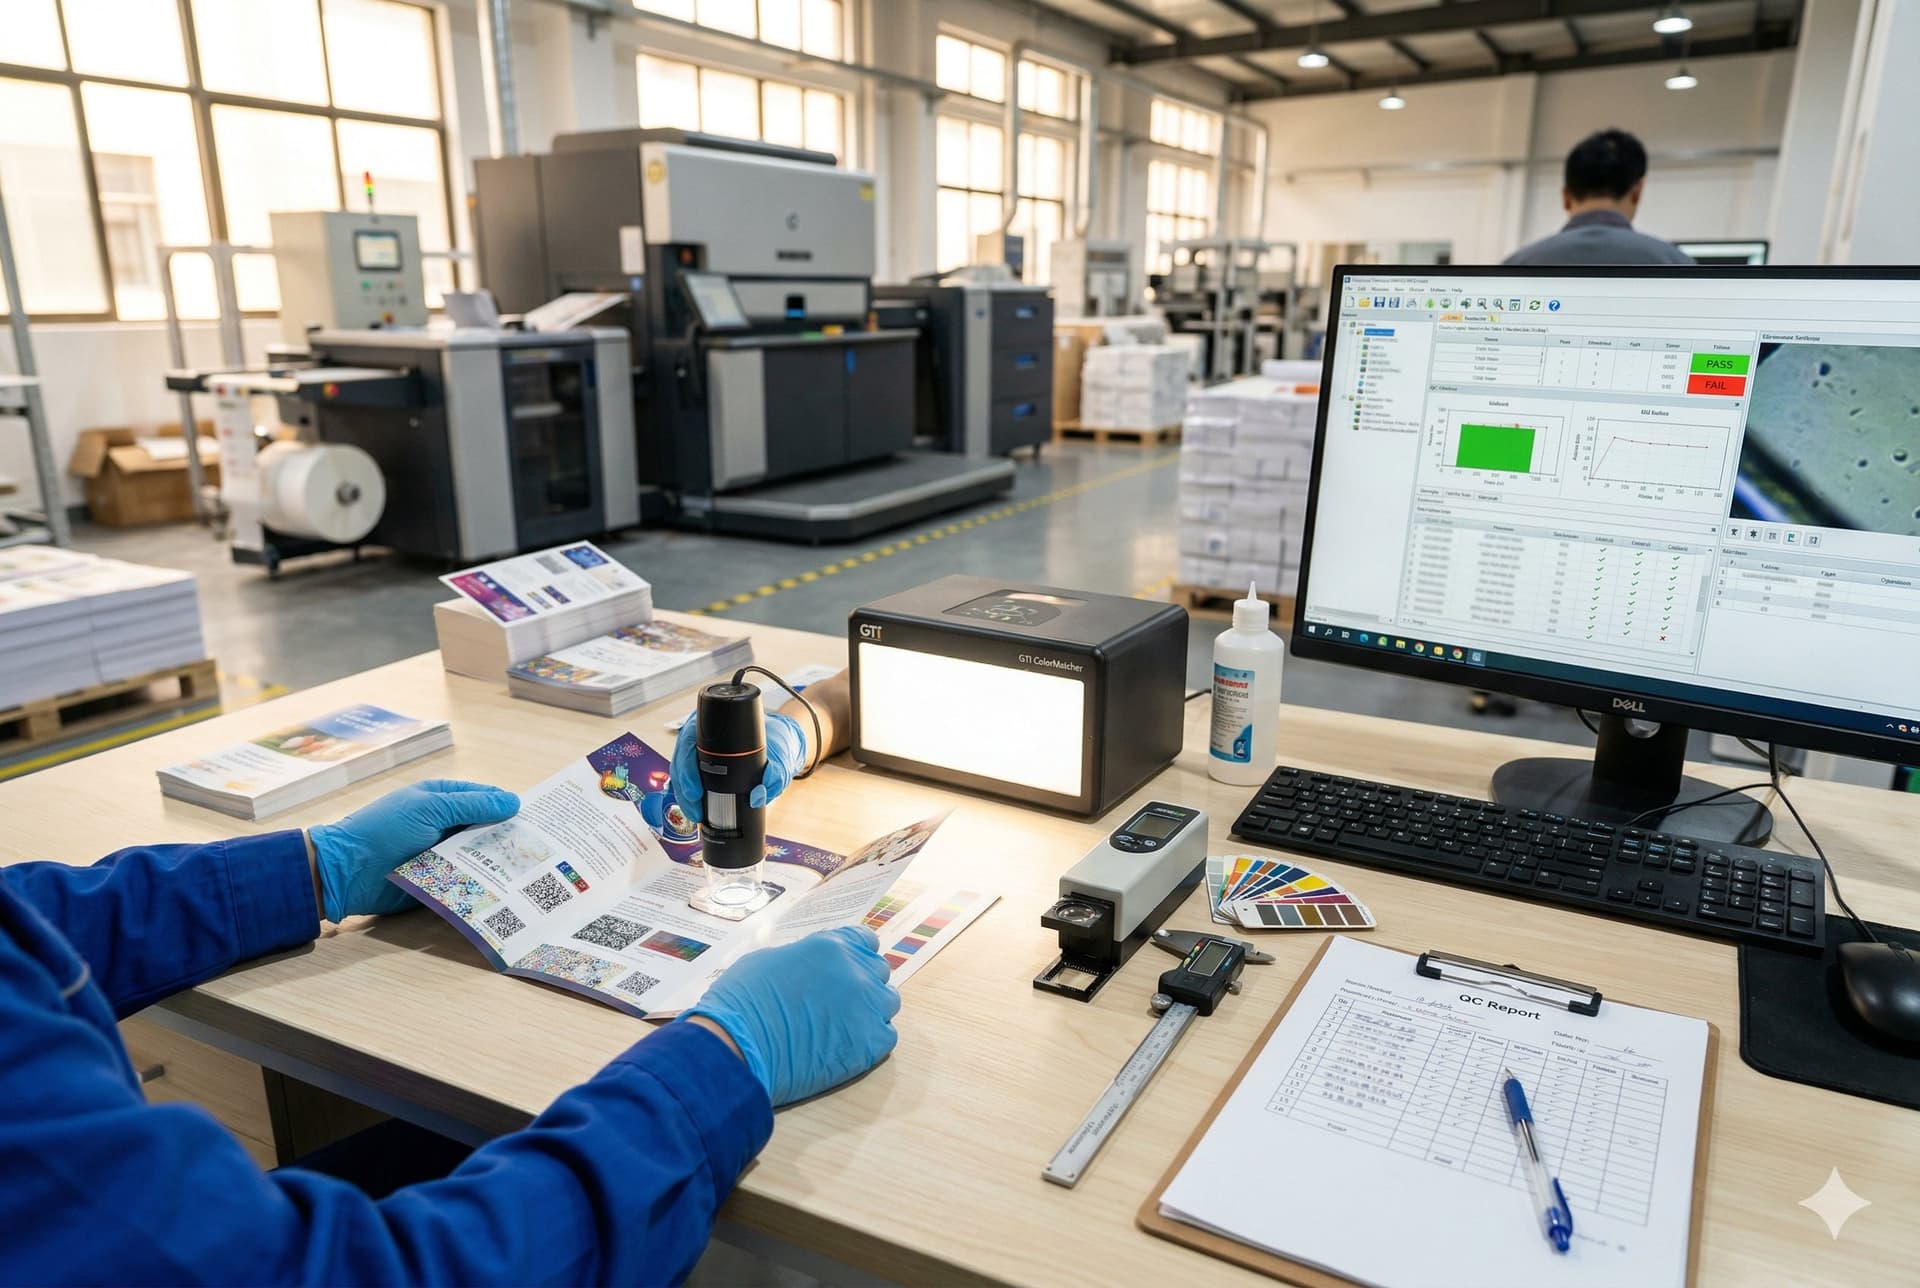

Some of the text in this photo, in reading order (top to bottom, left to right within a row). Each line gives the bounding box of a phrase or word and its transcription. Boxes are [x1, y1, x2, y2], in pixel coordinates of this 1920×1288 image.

[1706, 359, 1734, 369] PASS
[1704, 380, 1727, 390] FAIL
[1612, 697, 1646, 713] DELL
[1459, 993, 1484, 1006] QC
[1486, 1000, 1542, 1021] Report
